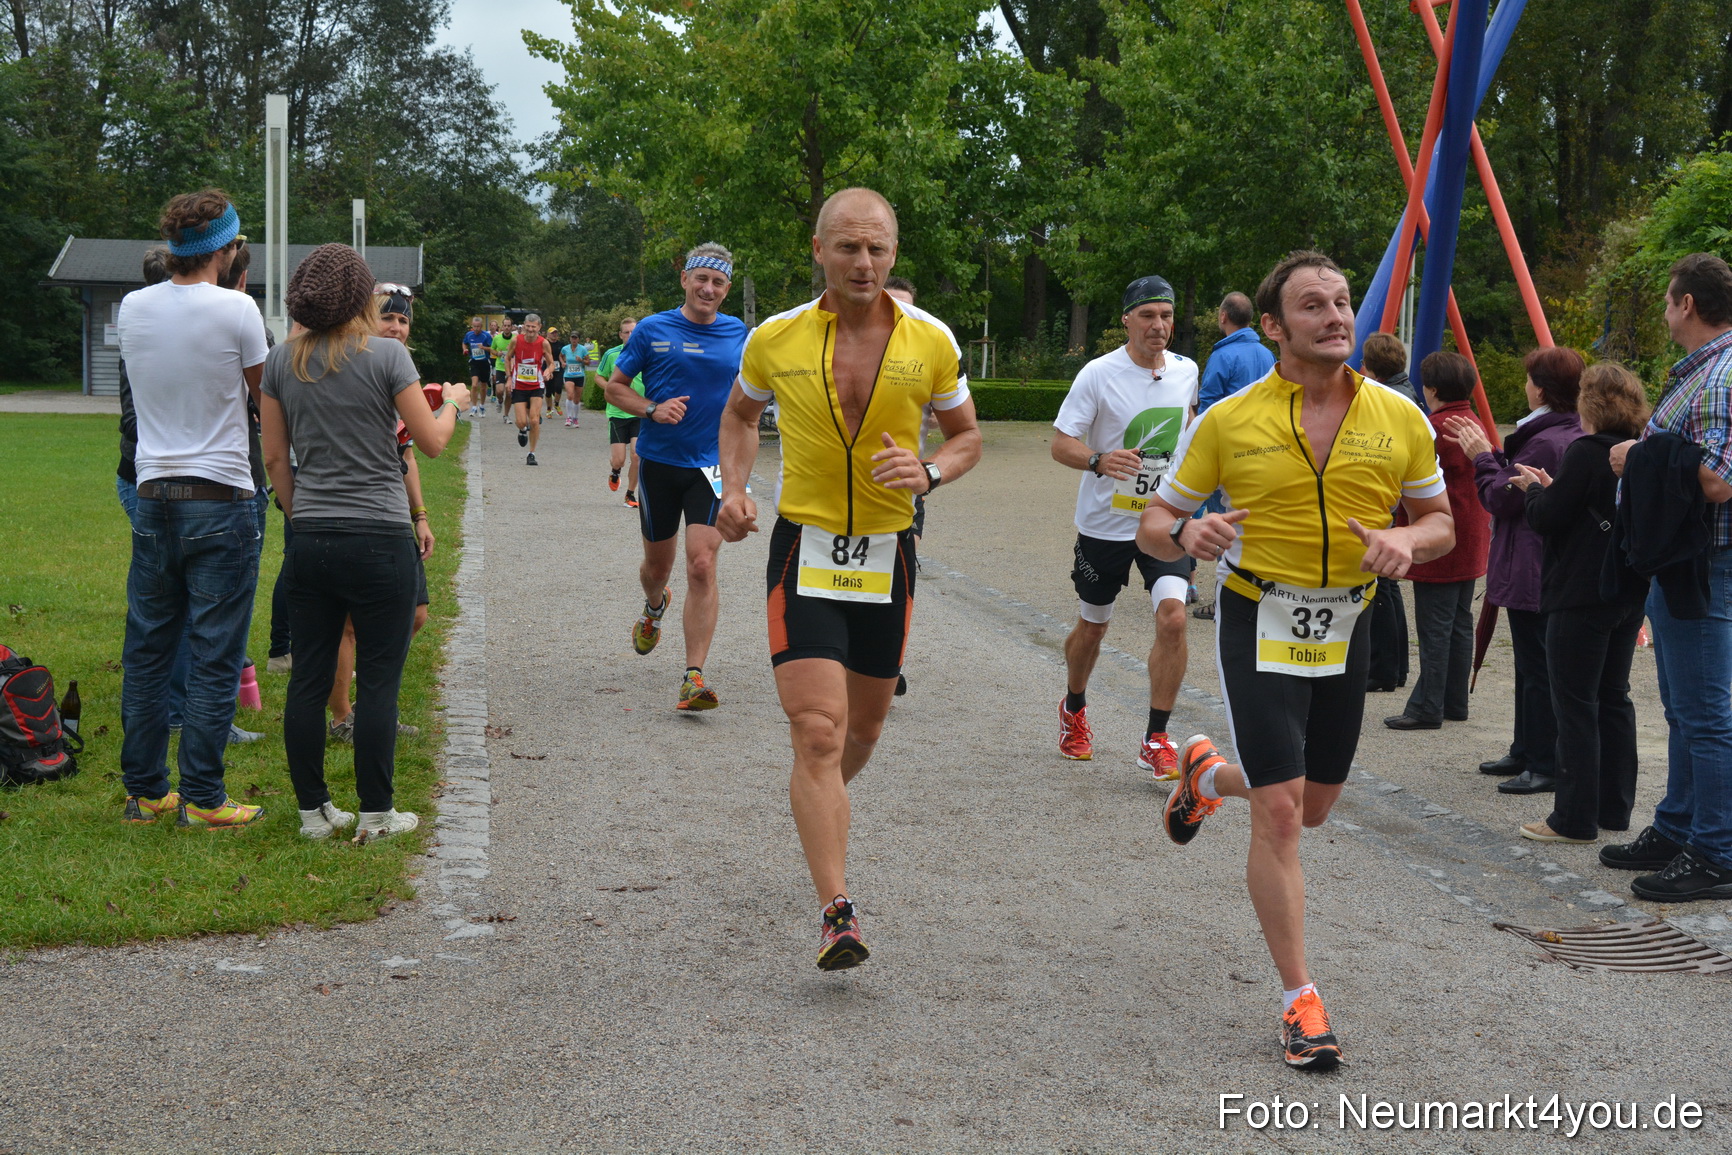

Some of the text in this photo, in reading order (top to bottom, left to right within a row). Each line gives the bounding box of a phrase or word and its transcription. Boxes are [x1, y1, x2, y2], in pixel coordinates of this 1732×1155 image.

[521, 367, 534, 376] 244
[153, 484, 193, 499] PMA
[1131, 500, 1147, 510] Rai
[831, 535, 870, 566] 84
[832, 574, 863, 588] Hans
[1301, 595, 1348, 604] Neumarkt
[1291, 607, 1334, 640] 33
[1288, 646, 1327, 663] Tobias
